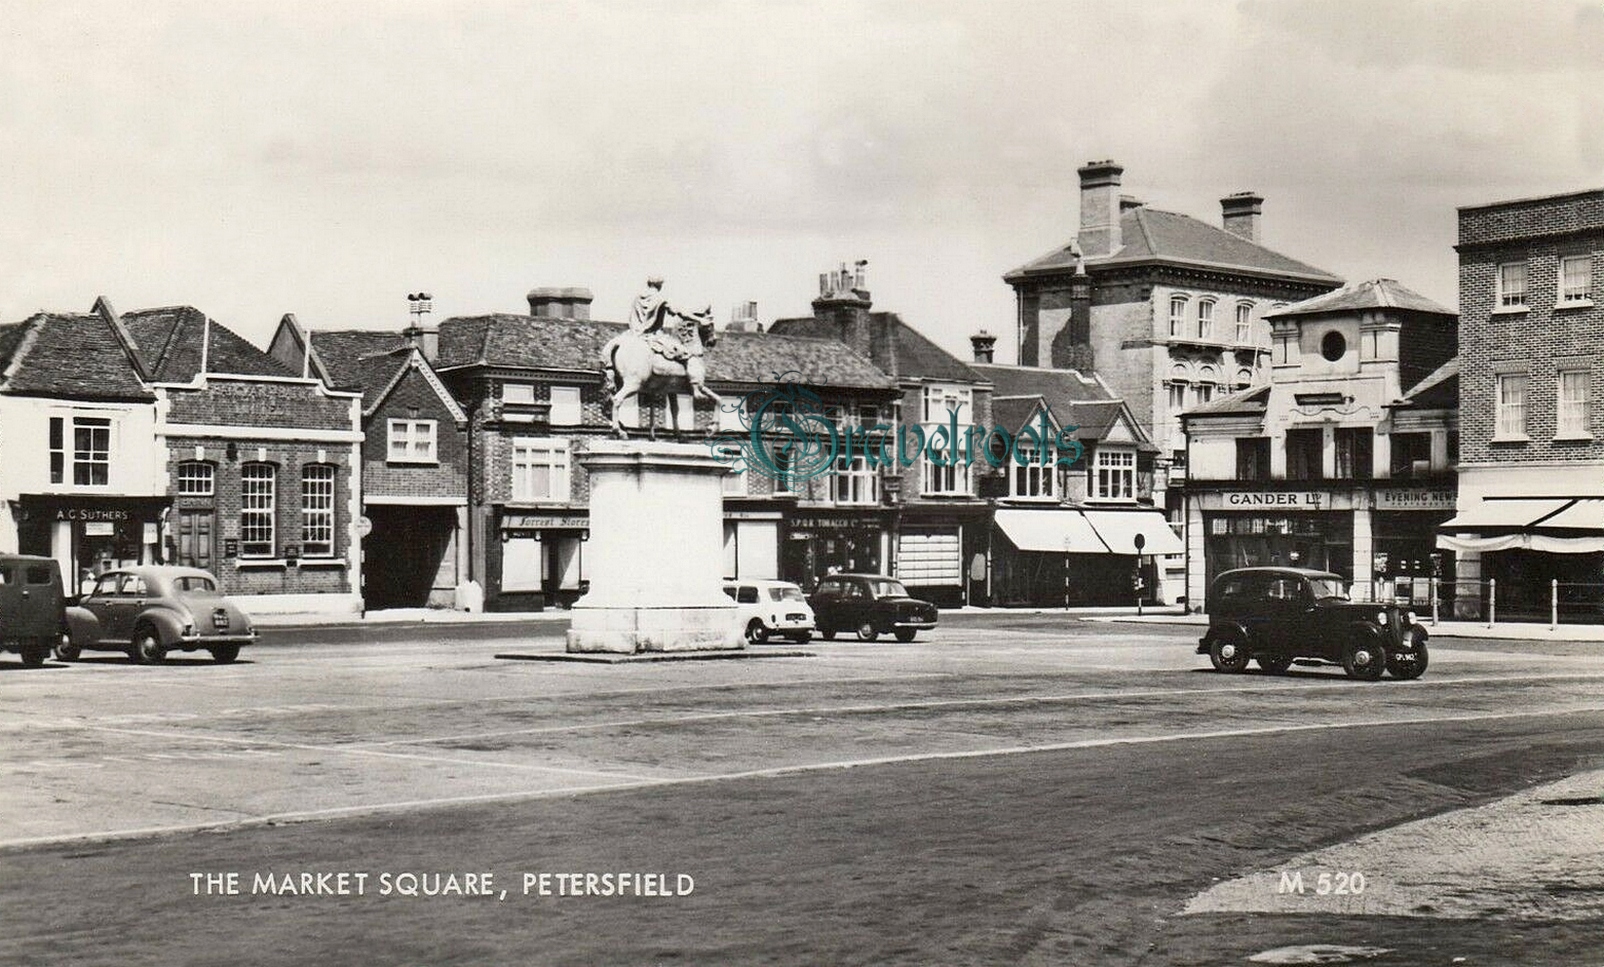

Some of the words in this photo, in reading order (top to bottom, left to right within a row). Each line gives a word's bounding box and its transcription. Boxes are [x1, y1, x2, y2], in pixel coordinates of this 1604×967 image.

[1229, 494, 1297, 505] GANDER
[1385, 492, 1428, 502] EVENING
[80, 509, 128, 520] SUTHERS
